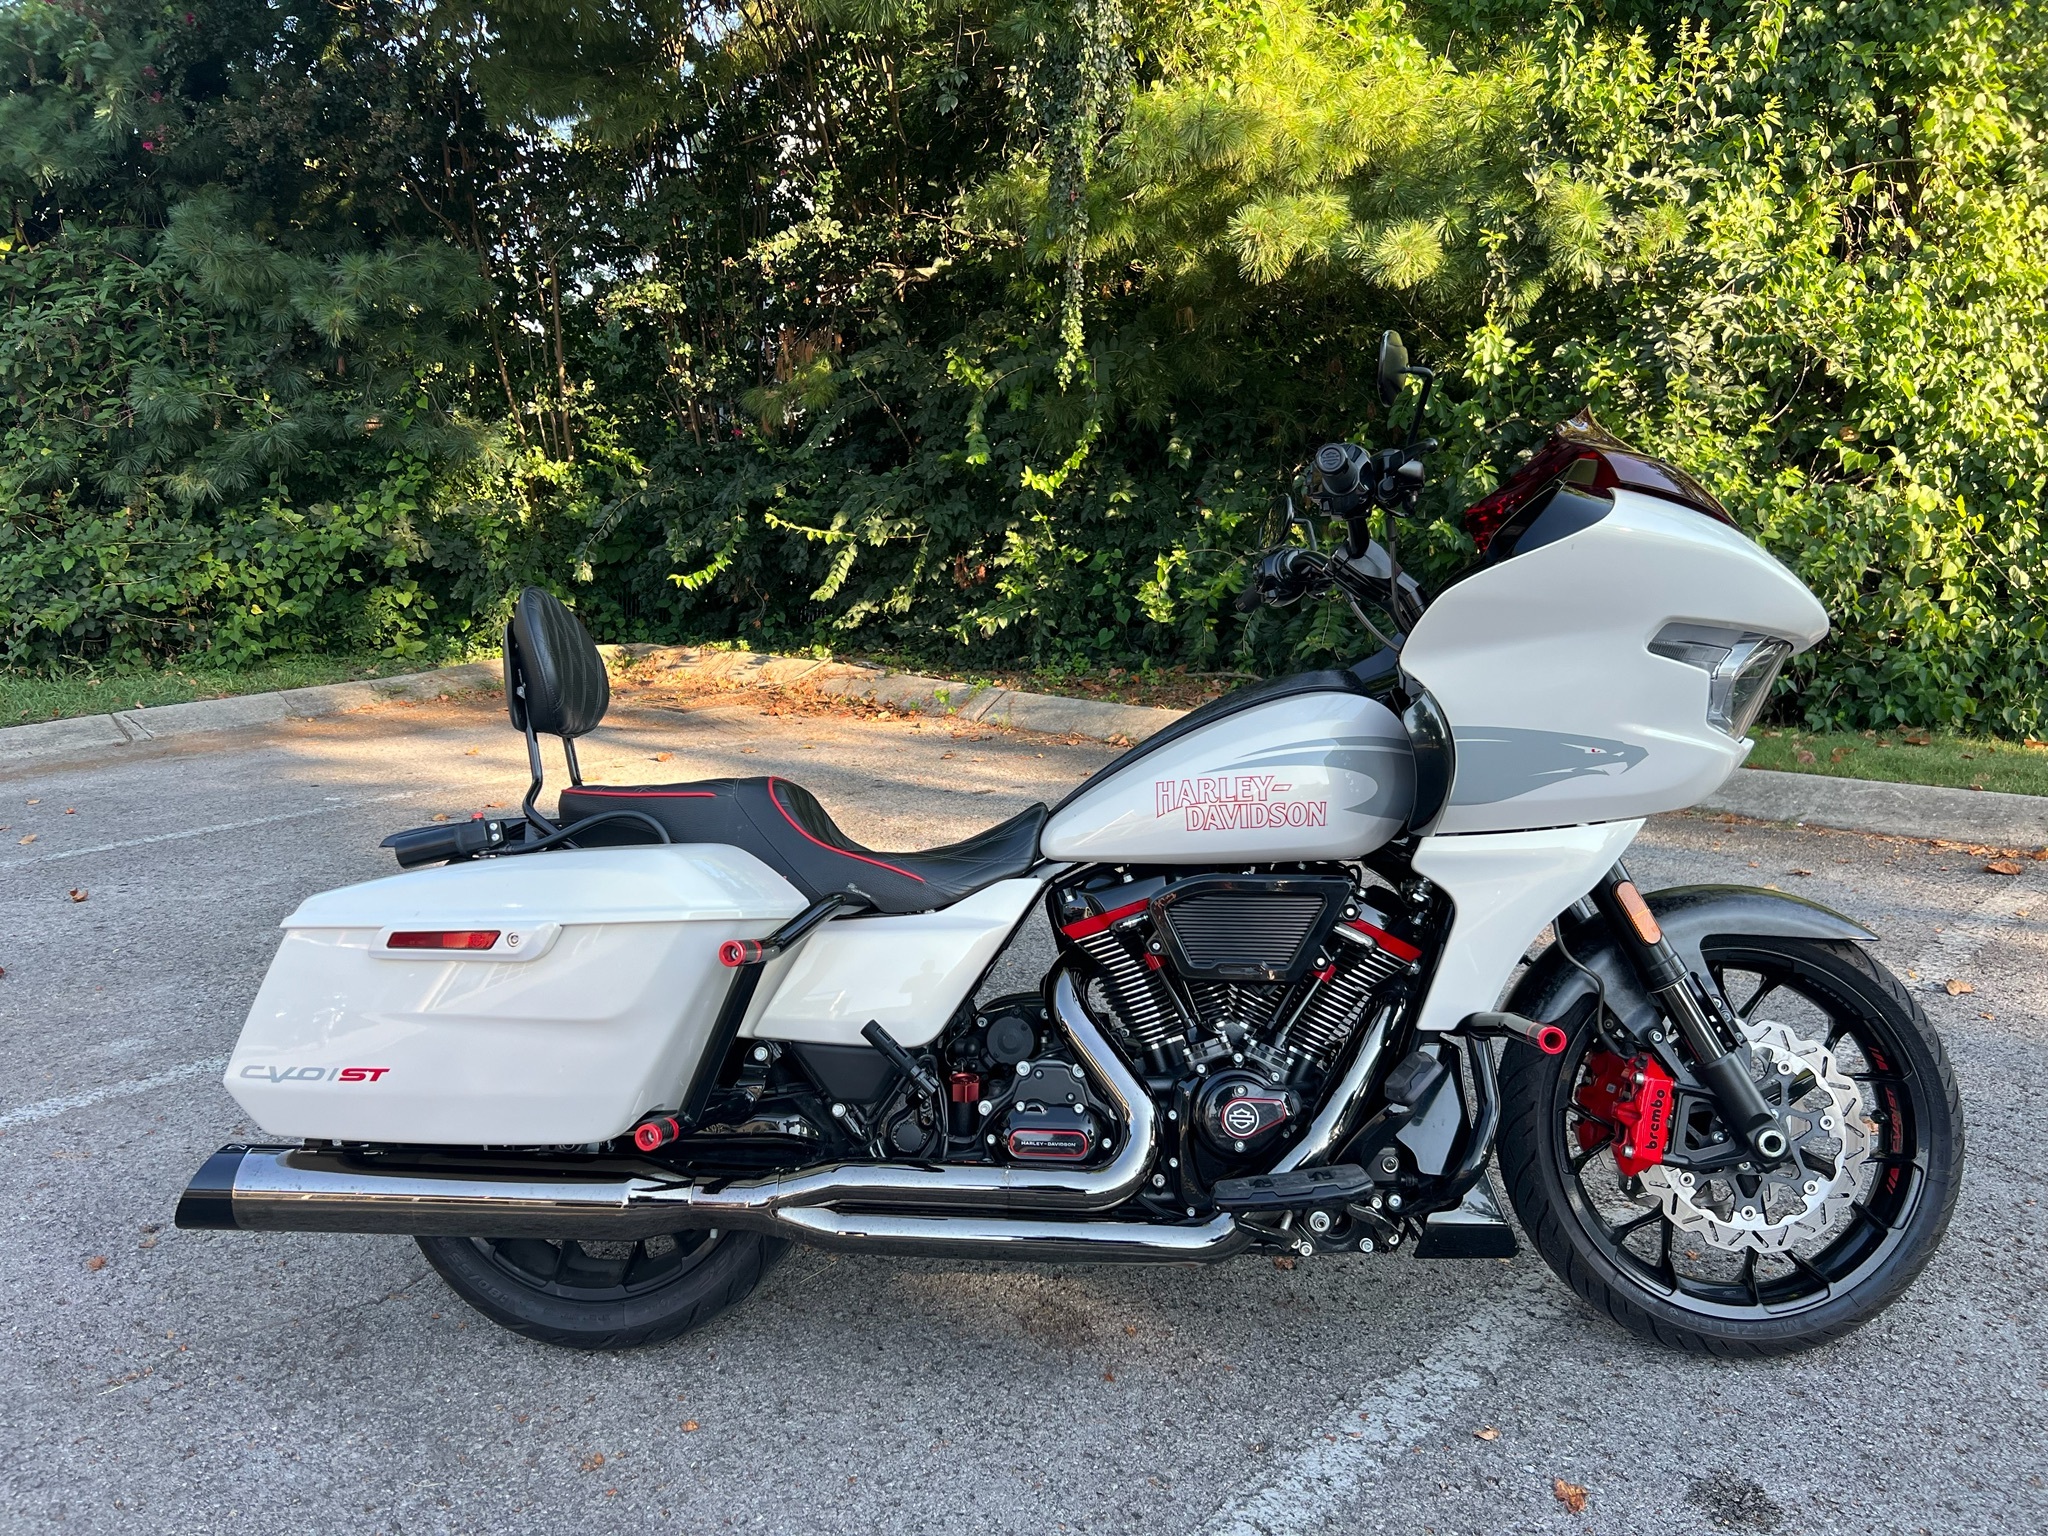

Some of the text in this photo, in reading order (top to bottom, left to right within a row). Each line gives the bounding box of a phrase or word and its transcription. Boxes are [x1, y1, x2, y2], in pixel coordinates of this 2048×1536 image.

[1156, 776, 1292, 818] HARLEY-
[1185, 802, 1327, 831] DAVIDSON
[1645, 1089, 1665, 1149] brembo
[1686, 1313, 1801, 1335] METZELER
